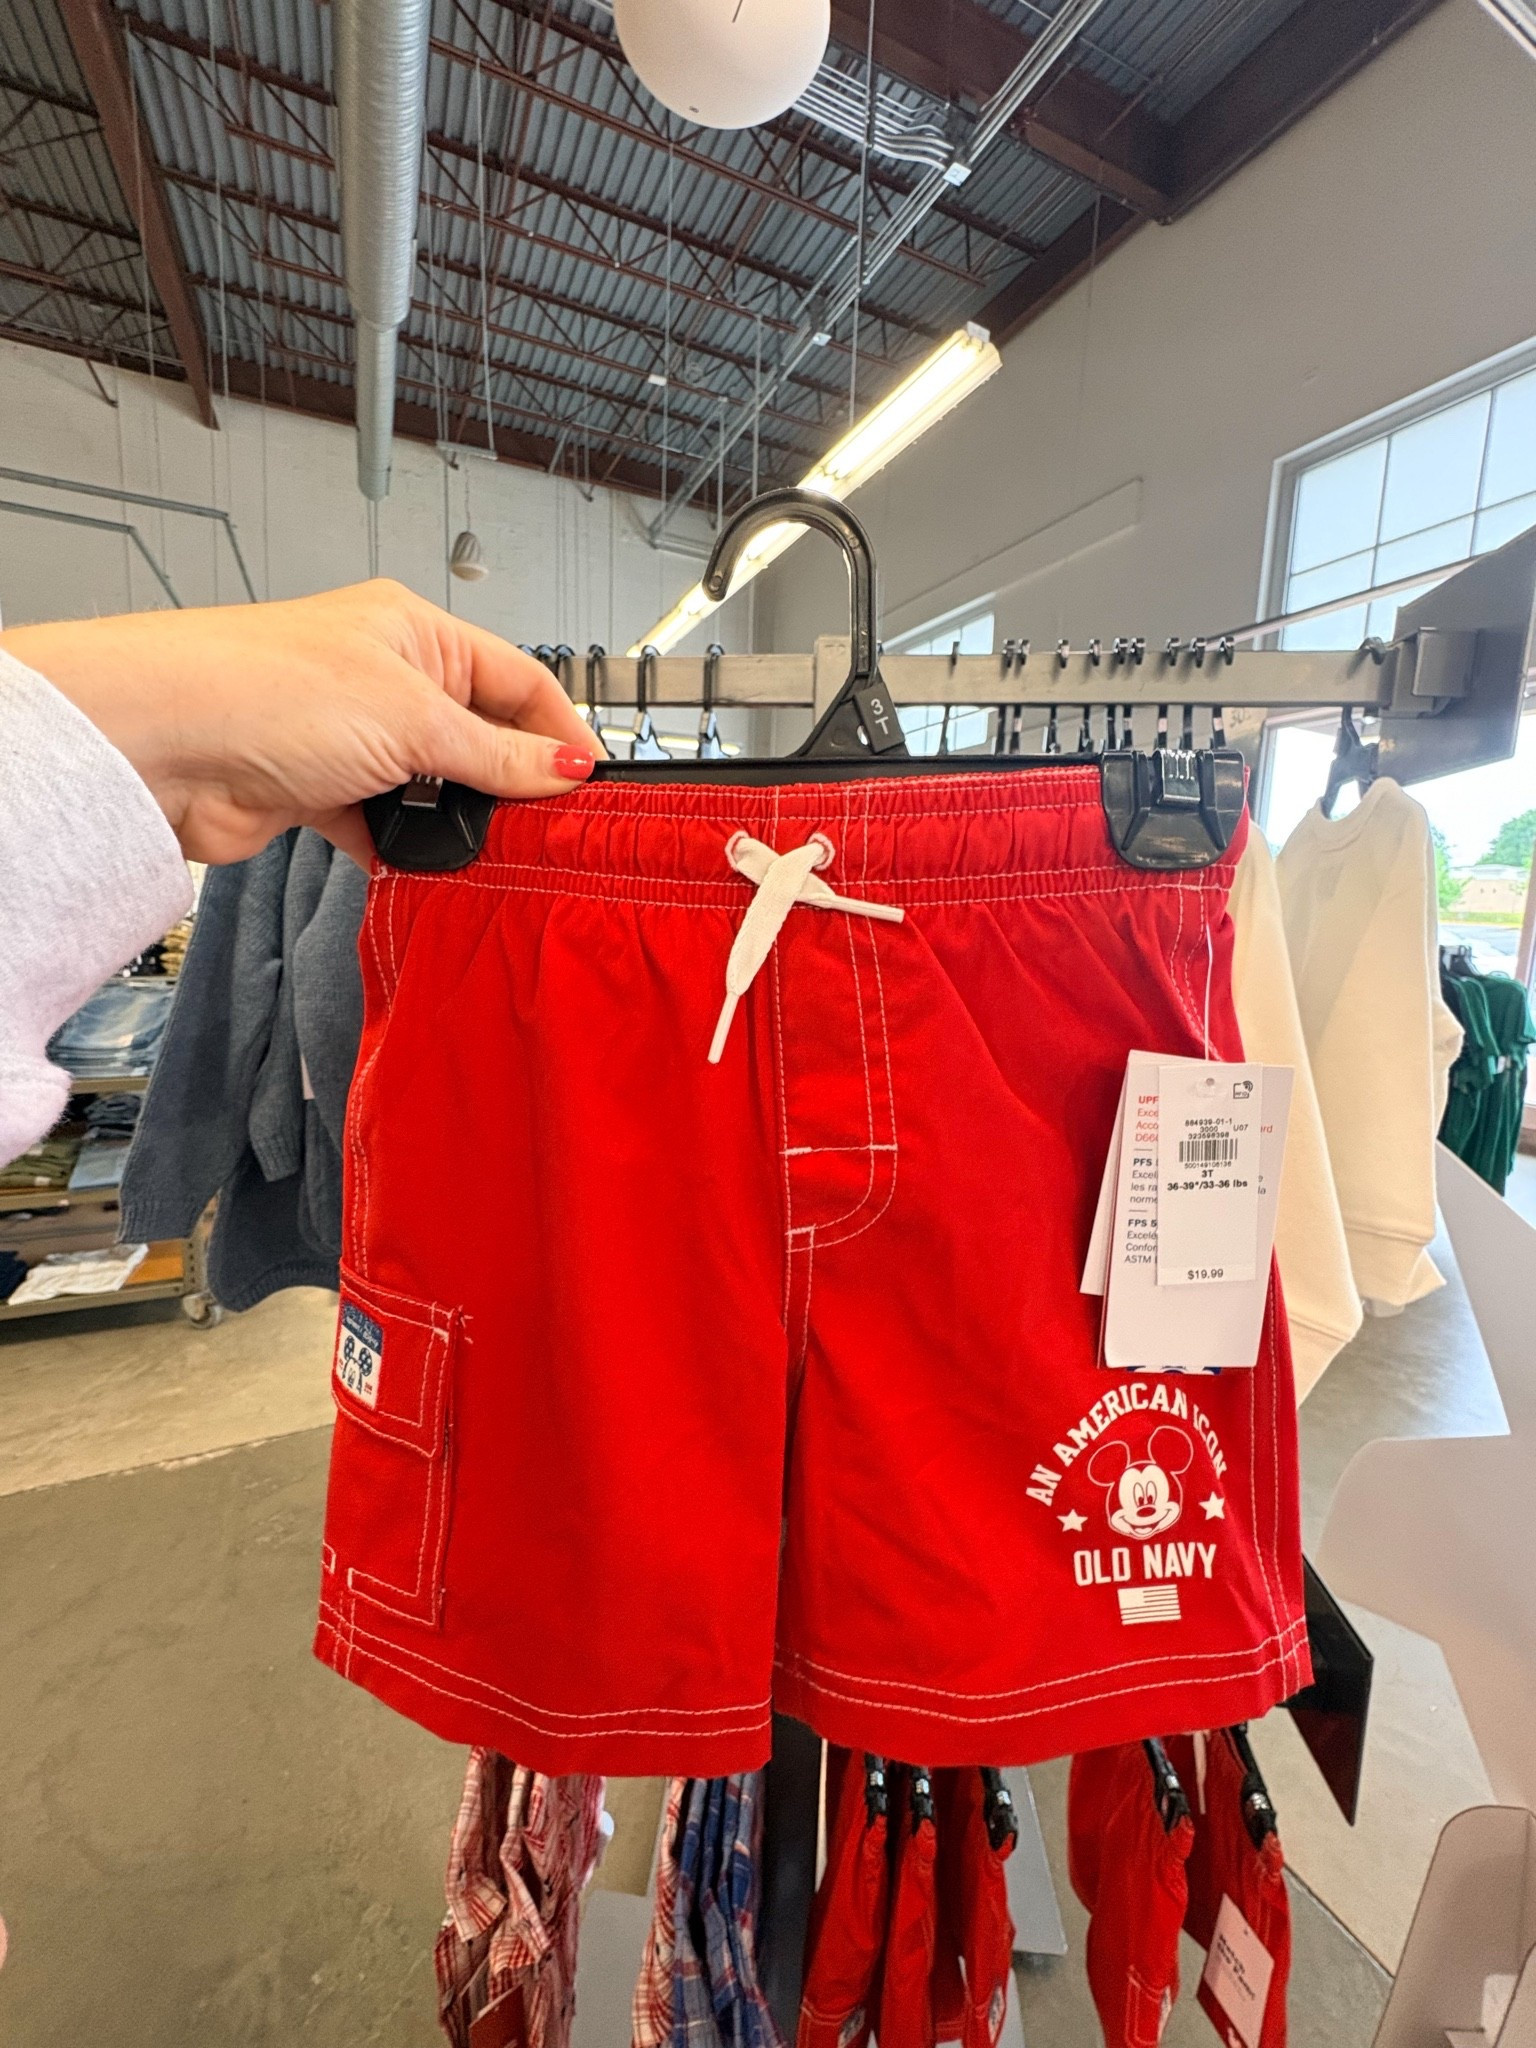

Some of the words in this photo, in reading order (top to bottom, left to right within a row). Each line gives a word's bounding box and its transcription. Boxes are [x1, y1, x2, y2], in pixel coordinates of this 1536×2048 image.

[870, 698, 889, 735] 3T
[1138, 1095, 1159, 1104] UPF
[1133, 1158, 1152, 1166] PFS
[1201, 1169, 1214, 1178] 3T
[1131, 1182, 1145, 1191] les
[1233, 1179, 1248, 1188] lbs
[1128, 1219, 1148, 1227] FPS
[1124, 1255, 1152, 1263] ASTM
[1187, 1268, 1224, 1280] $19.99
[1025, 1463, 1063, 1507] AN
[1053, 1382, 1189, 1467] AMERICAN
[1192, 1404, 1228, 1480] ICON
[1073, 1546, 1131, 1587] OLD
[1142, 1542, 1217, 1580] NAVY
